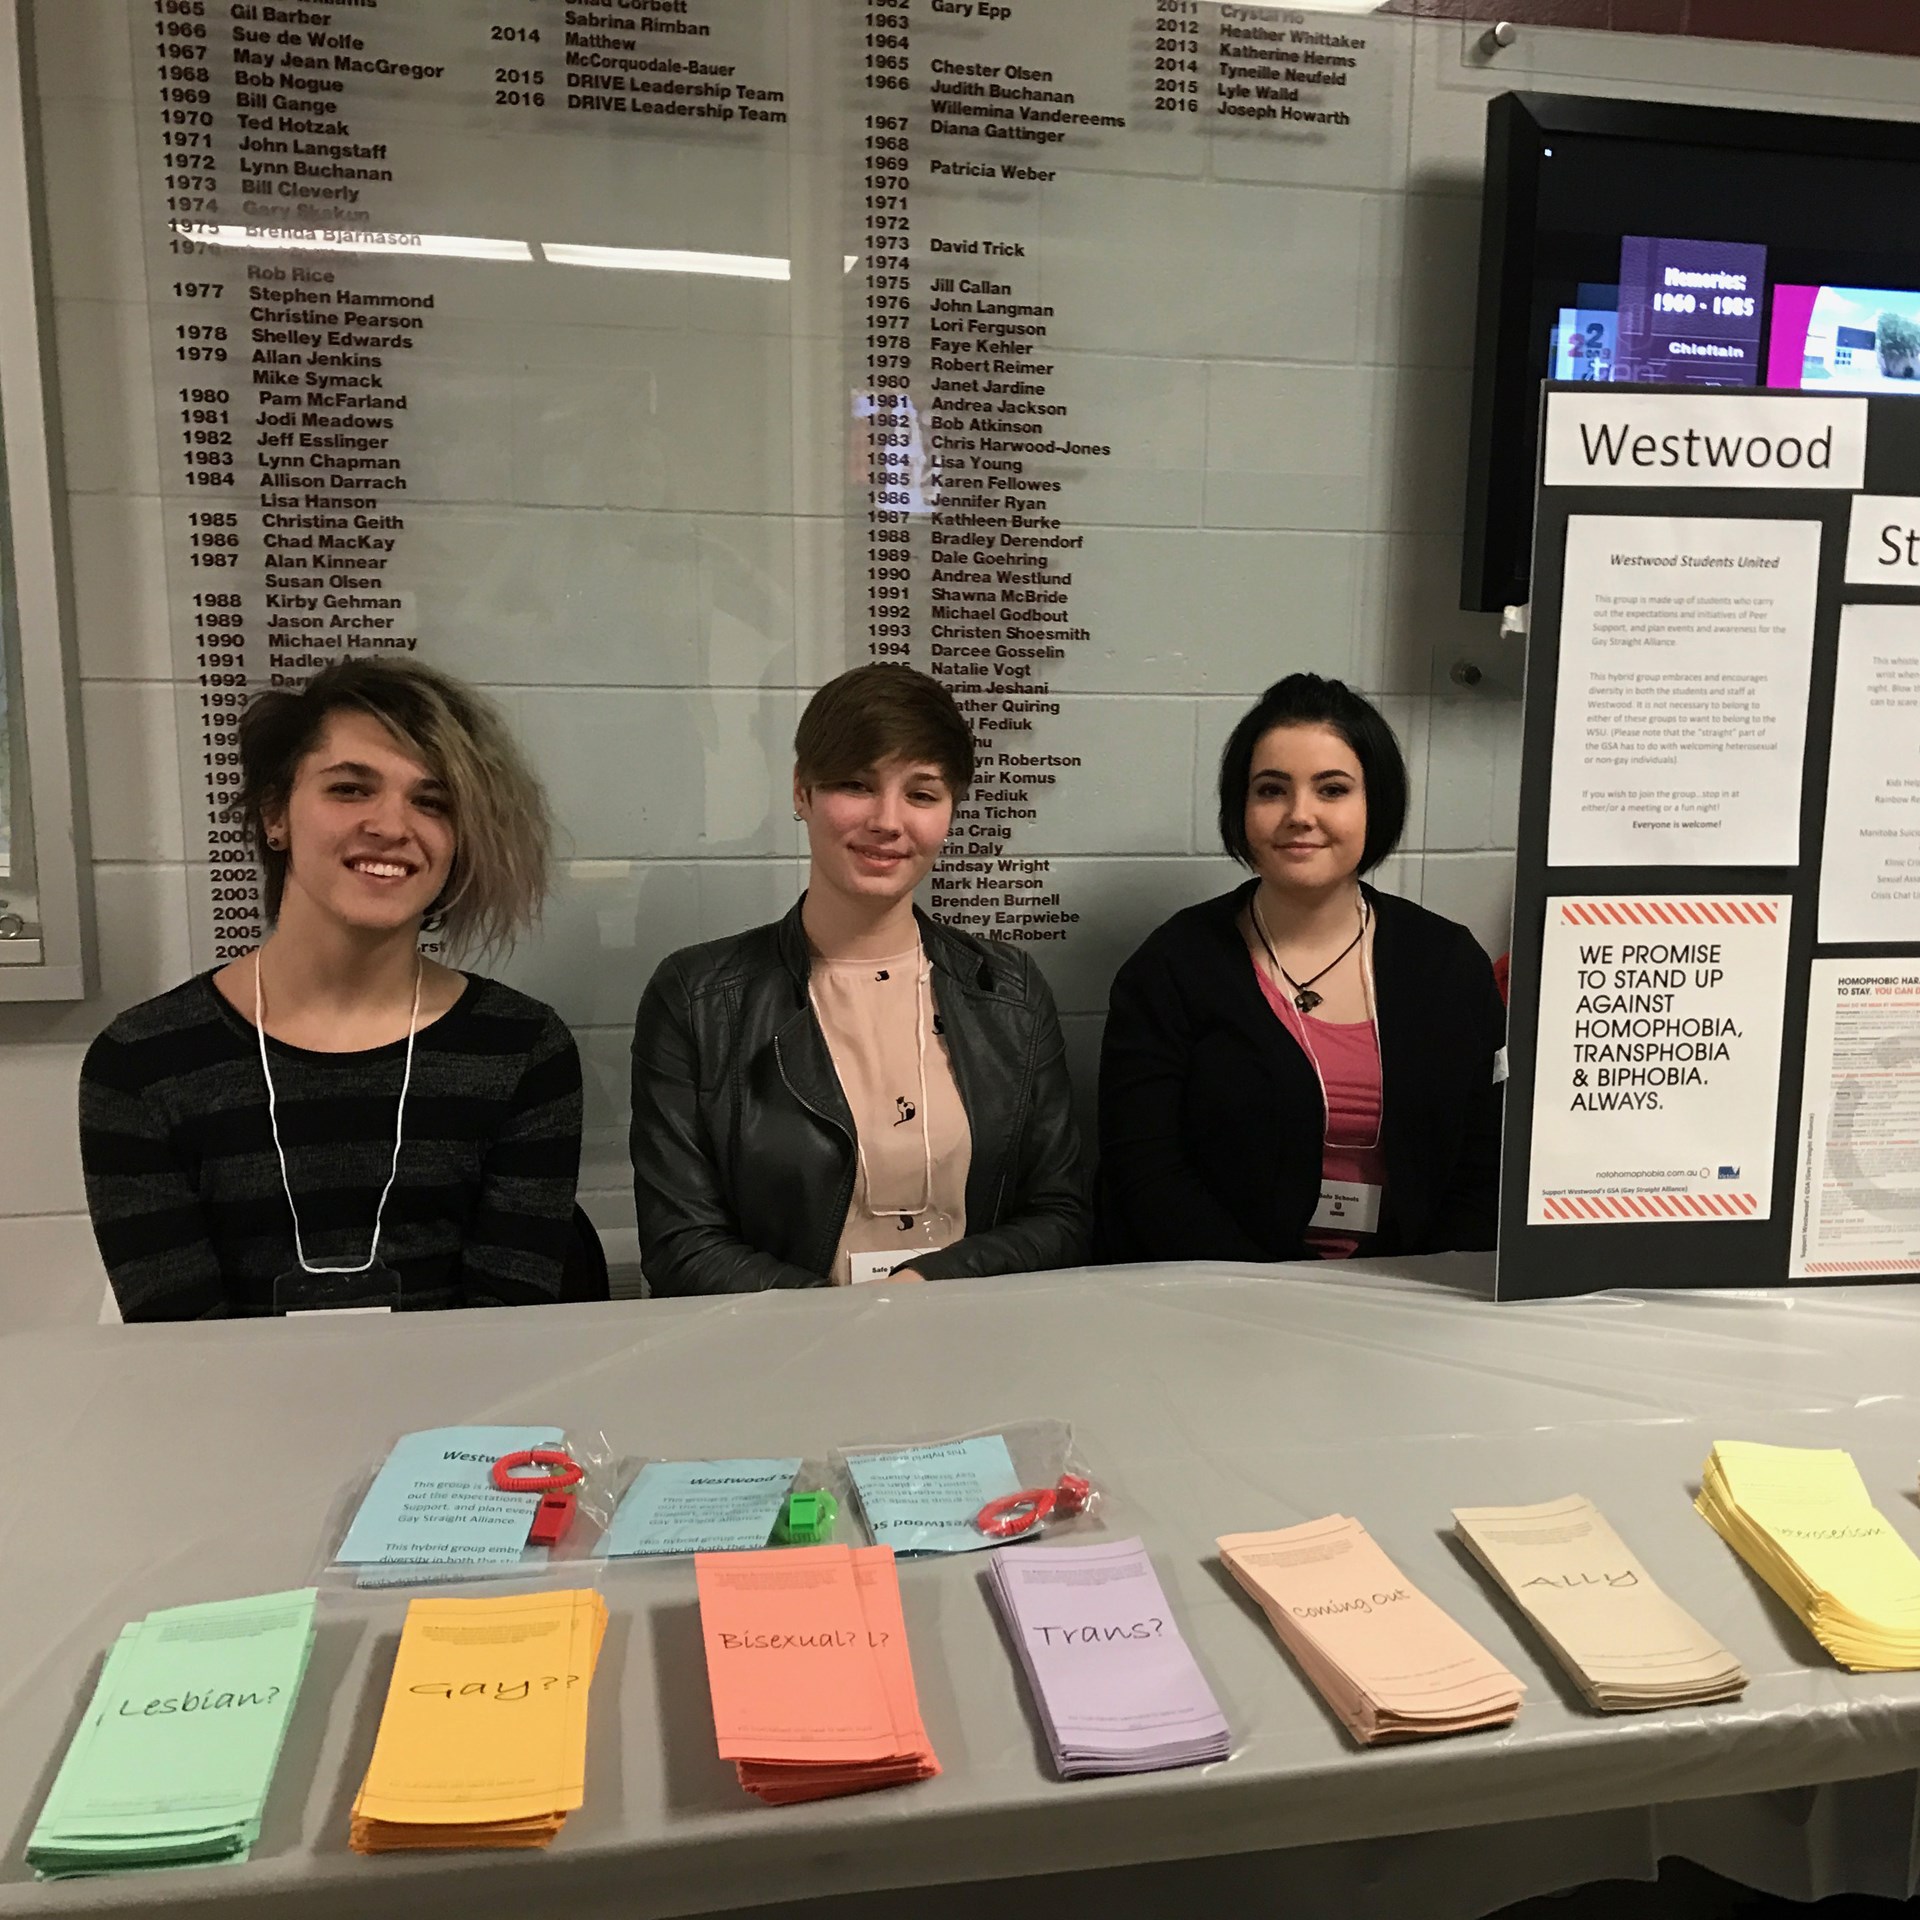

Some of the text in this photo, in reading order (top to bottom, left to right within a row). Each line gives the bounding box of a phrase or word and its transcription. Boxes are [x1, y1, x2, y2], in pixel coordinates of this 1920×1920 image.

[565, 10, 711, 37] Sabrina Rimban
[155, 21, 364, 51] 1966 Sue de Wolfe
[491, 25, 637, 51] 2014 Matthew
[156, 43, 445, 80] 1967 May Jean MacGregor
[566, 51, 736, 78] McCorquodale-Bauer
[864, 54, 1053, 82] 1965 Chester Olsen
[157, 65, 344, 95] 1968 Bob Nogue
[495, 90, 788, 123] 2016 DRIVE Leadership Team
[1155, 97, 1350, 126] 2016 Joseph Howarth
[160, 109, 350, 136] 1970 Ted Hotzak
[163, 153, 393, 182] 1972 Lynn Buchanan
[864, 156, 1056, 182] 1969 Patricia Weber
[864, 235, 1026, 257] 1973 David Trick
[172, 282, 435, 309] 1977 Stephen Hammond
[1653, 291, 1697, 315] 1960
[1713, 297, 1755, 318] 1985
[176, 325, 414, 349] 1978 Shelley Edwards
[1668, 341, 1745, 359] Chieftain
[867, 354, 1054, 375] 1979 Robert Reimer
[178, 388, 408, 410] 1980 Pam McFarland
[182, 430, 389, 451] 1982 Jeff Esslinger
[1579, 422, 1834, 470] Westwood
[185, 471, 407, 490] 1984 Allison Darrach
[867, 529, 1084, 549] 1988 Bradley Derendorf
[1610, 553, 1780, 570] Westwood Students United
[265, 574, 382, 590] Susan Olsen
[867, 586, 1069, 604] 1991 Shawna McBride
[195, 633, 418, 651] 1990 Michael Hannay
[867, 624, 1090, 642] 1993 Christen Shoesmith
[198, 673, 248, 688] 1992
[931, 662, 1032, 681] Natalie Vogt
[1632, 819, 1722, 831] Everyone is welcome!
[931, 877, 1044, 890] Mark Hearson
[211, 888, 259, 902] 2003
[214, 926, 262, 940] 2005
[1579, 944, 1722, 965] WE PROMISE
[1577, 969, 1724, 990] TO STAND UP
[1837, 976, 1920, 986] HOMOPHOBIC HAR
[1575, 994, 1675, 1014] AGAINST
[1575, 1018, 1744, 1039] HOMOPHOBIA,
[1573, 1042, 1731, 1063] TRANSPHOBIA
[1572, 1067, 1709, 1087] & BIPHOBIA.
[1570, 1091, 1664, 1111] ALWAYS.
[871, 1266, 888, 1274] Safe
[690, 1473, 776, 1486] Westwood
[1519, 1567, 1640, 1590] ALLY
[717, 1629, 858, 1651] Bisexual?
[1032, 1616, 1166, 1647] Trans?
[118, 1685, 281, 1718] Lesbian?
